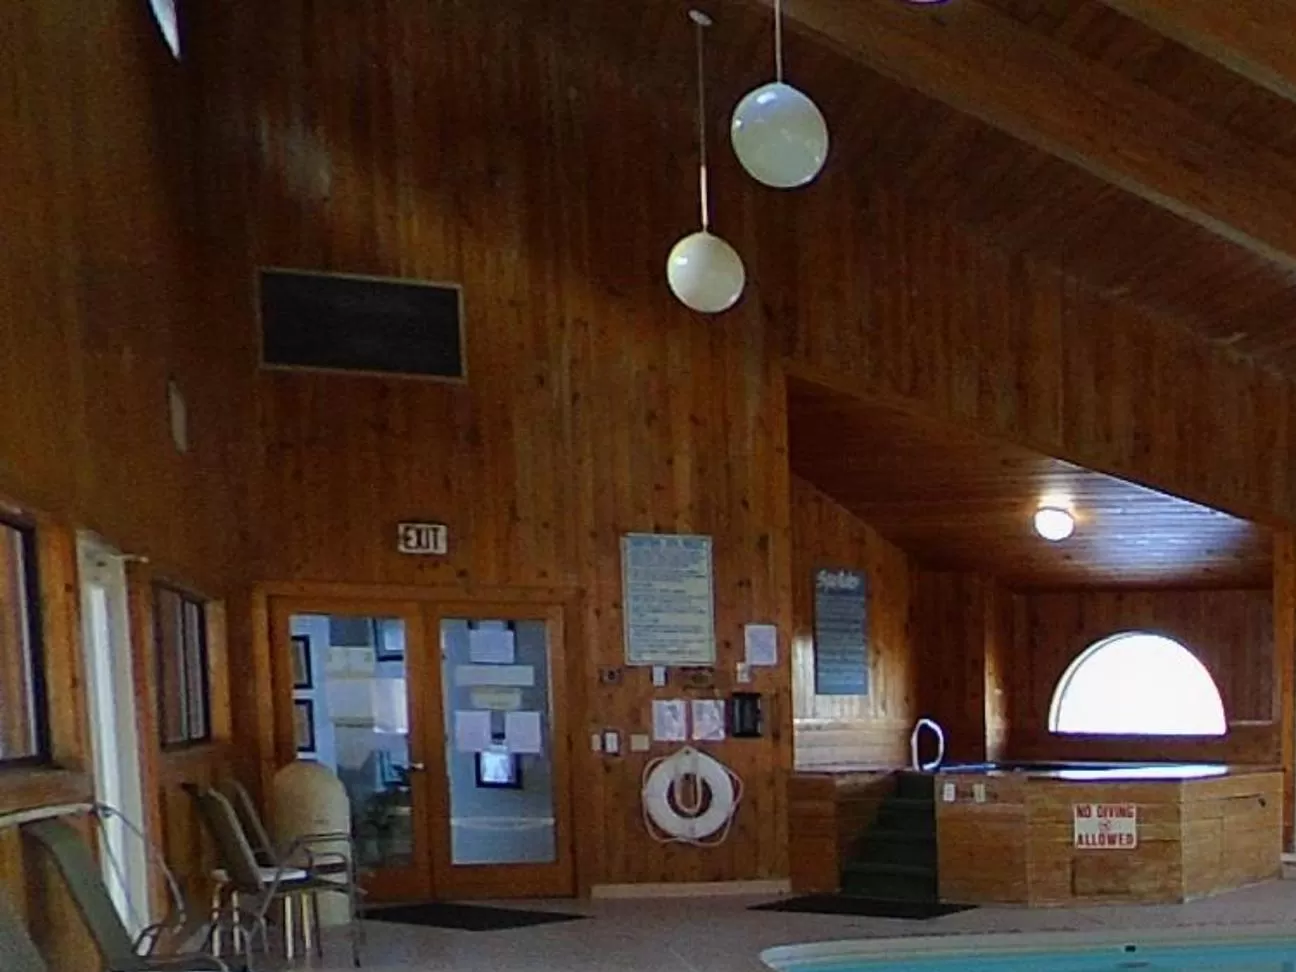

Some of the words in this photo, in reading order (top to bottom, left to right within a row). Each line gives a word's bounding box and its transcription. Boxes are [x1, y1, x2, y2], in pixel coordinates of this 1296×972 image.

[403, 525, 441, 550] EXIT
[1077, 804, 1091, 818] NO
[1078, 833, 1134, 846] ALLOWED
